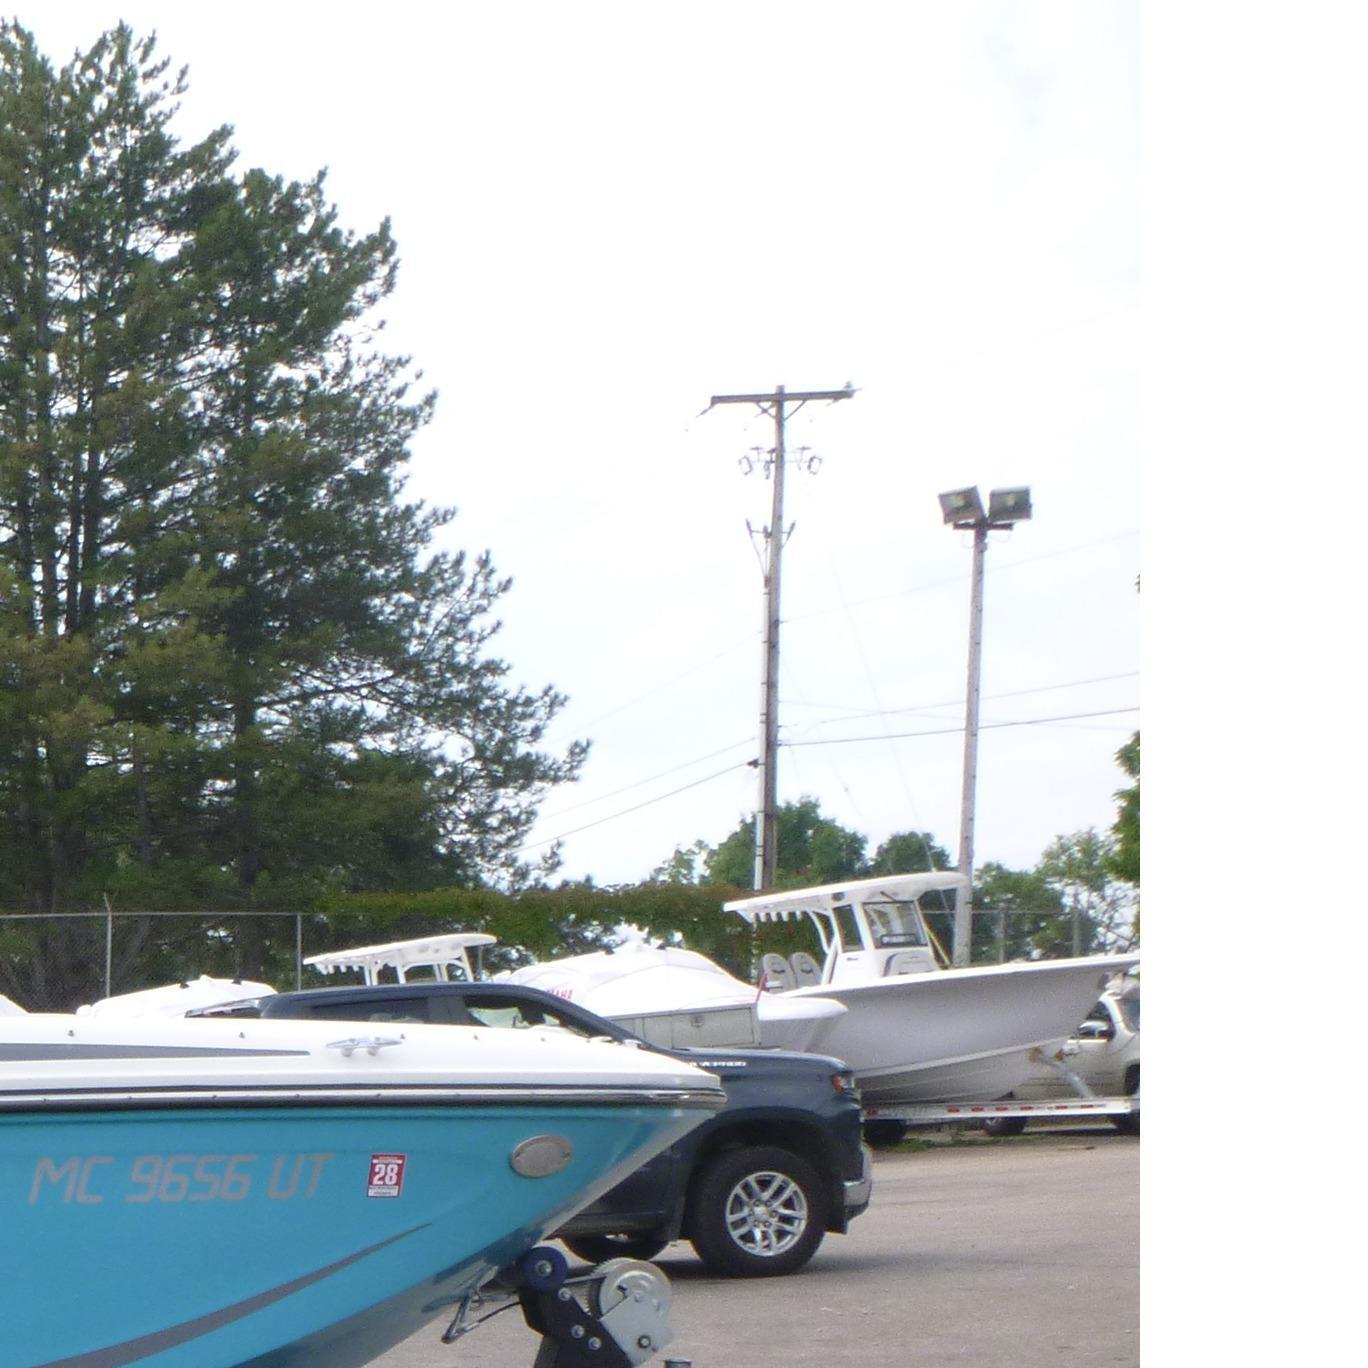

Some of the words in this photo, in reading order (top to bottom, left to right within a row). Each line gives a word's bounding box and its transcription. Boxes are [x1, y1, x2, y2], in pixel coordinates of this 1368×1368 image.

[27, 1155, 114, 1206] MC
[124, 1154, 258, 1203] 9656
[267, 1152, 335, 1201] UT
[372, 1163, 399, 1185] 28
